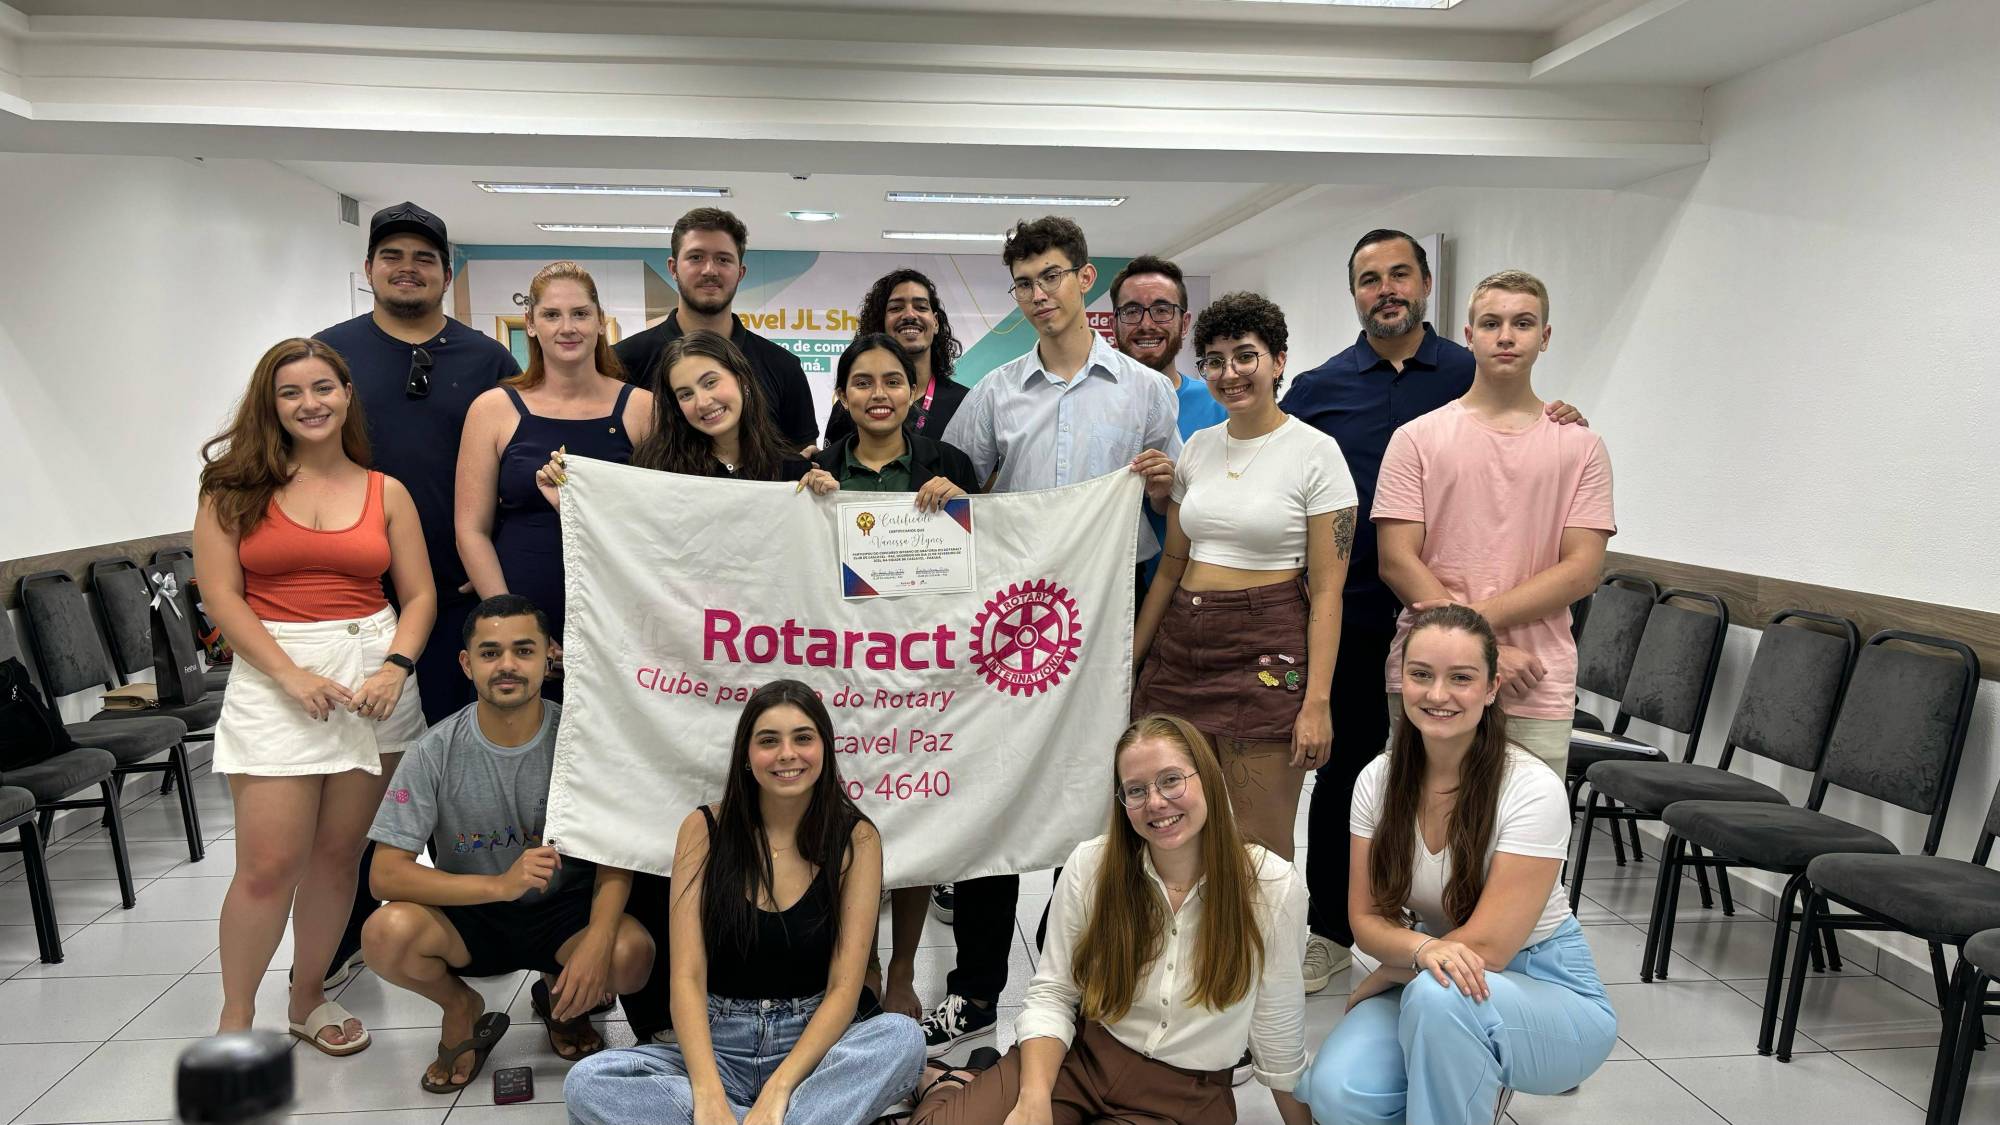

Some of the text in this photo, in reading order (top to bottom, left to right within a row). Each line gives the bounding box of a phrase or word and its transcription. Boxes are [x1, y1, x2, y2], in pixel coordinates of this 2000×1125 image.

[512, 293, 530, 306] Ca
[738, 308, 859, 331] avel JL Sh
[793, 339, 811, 352] de
[801, 358, 825, 371] ná.
[1002, 592, 1051, 612] ROTARY
[703, 608, 956, 671] Rotaract
[988, 647, 1066, 684] INTERNATIONAL
[636, 667, 709, 698] Clube
[833, 686, 865, 708] do
[873, 688, 956, 712] Rotary
[833, 728, 954, 755] cavel Paz
[875, 770, 951, 801] 4640
